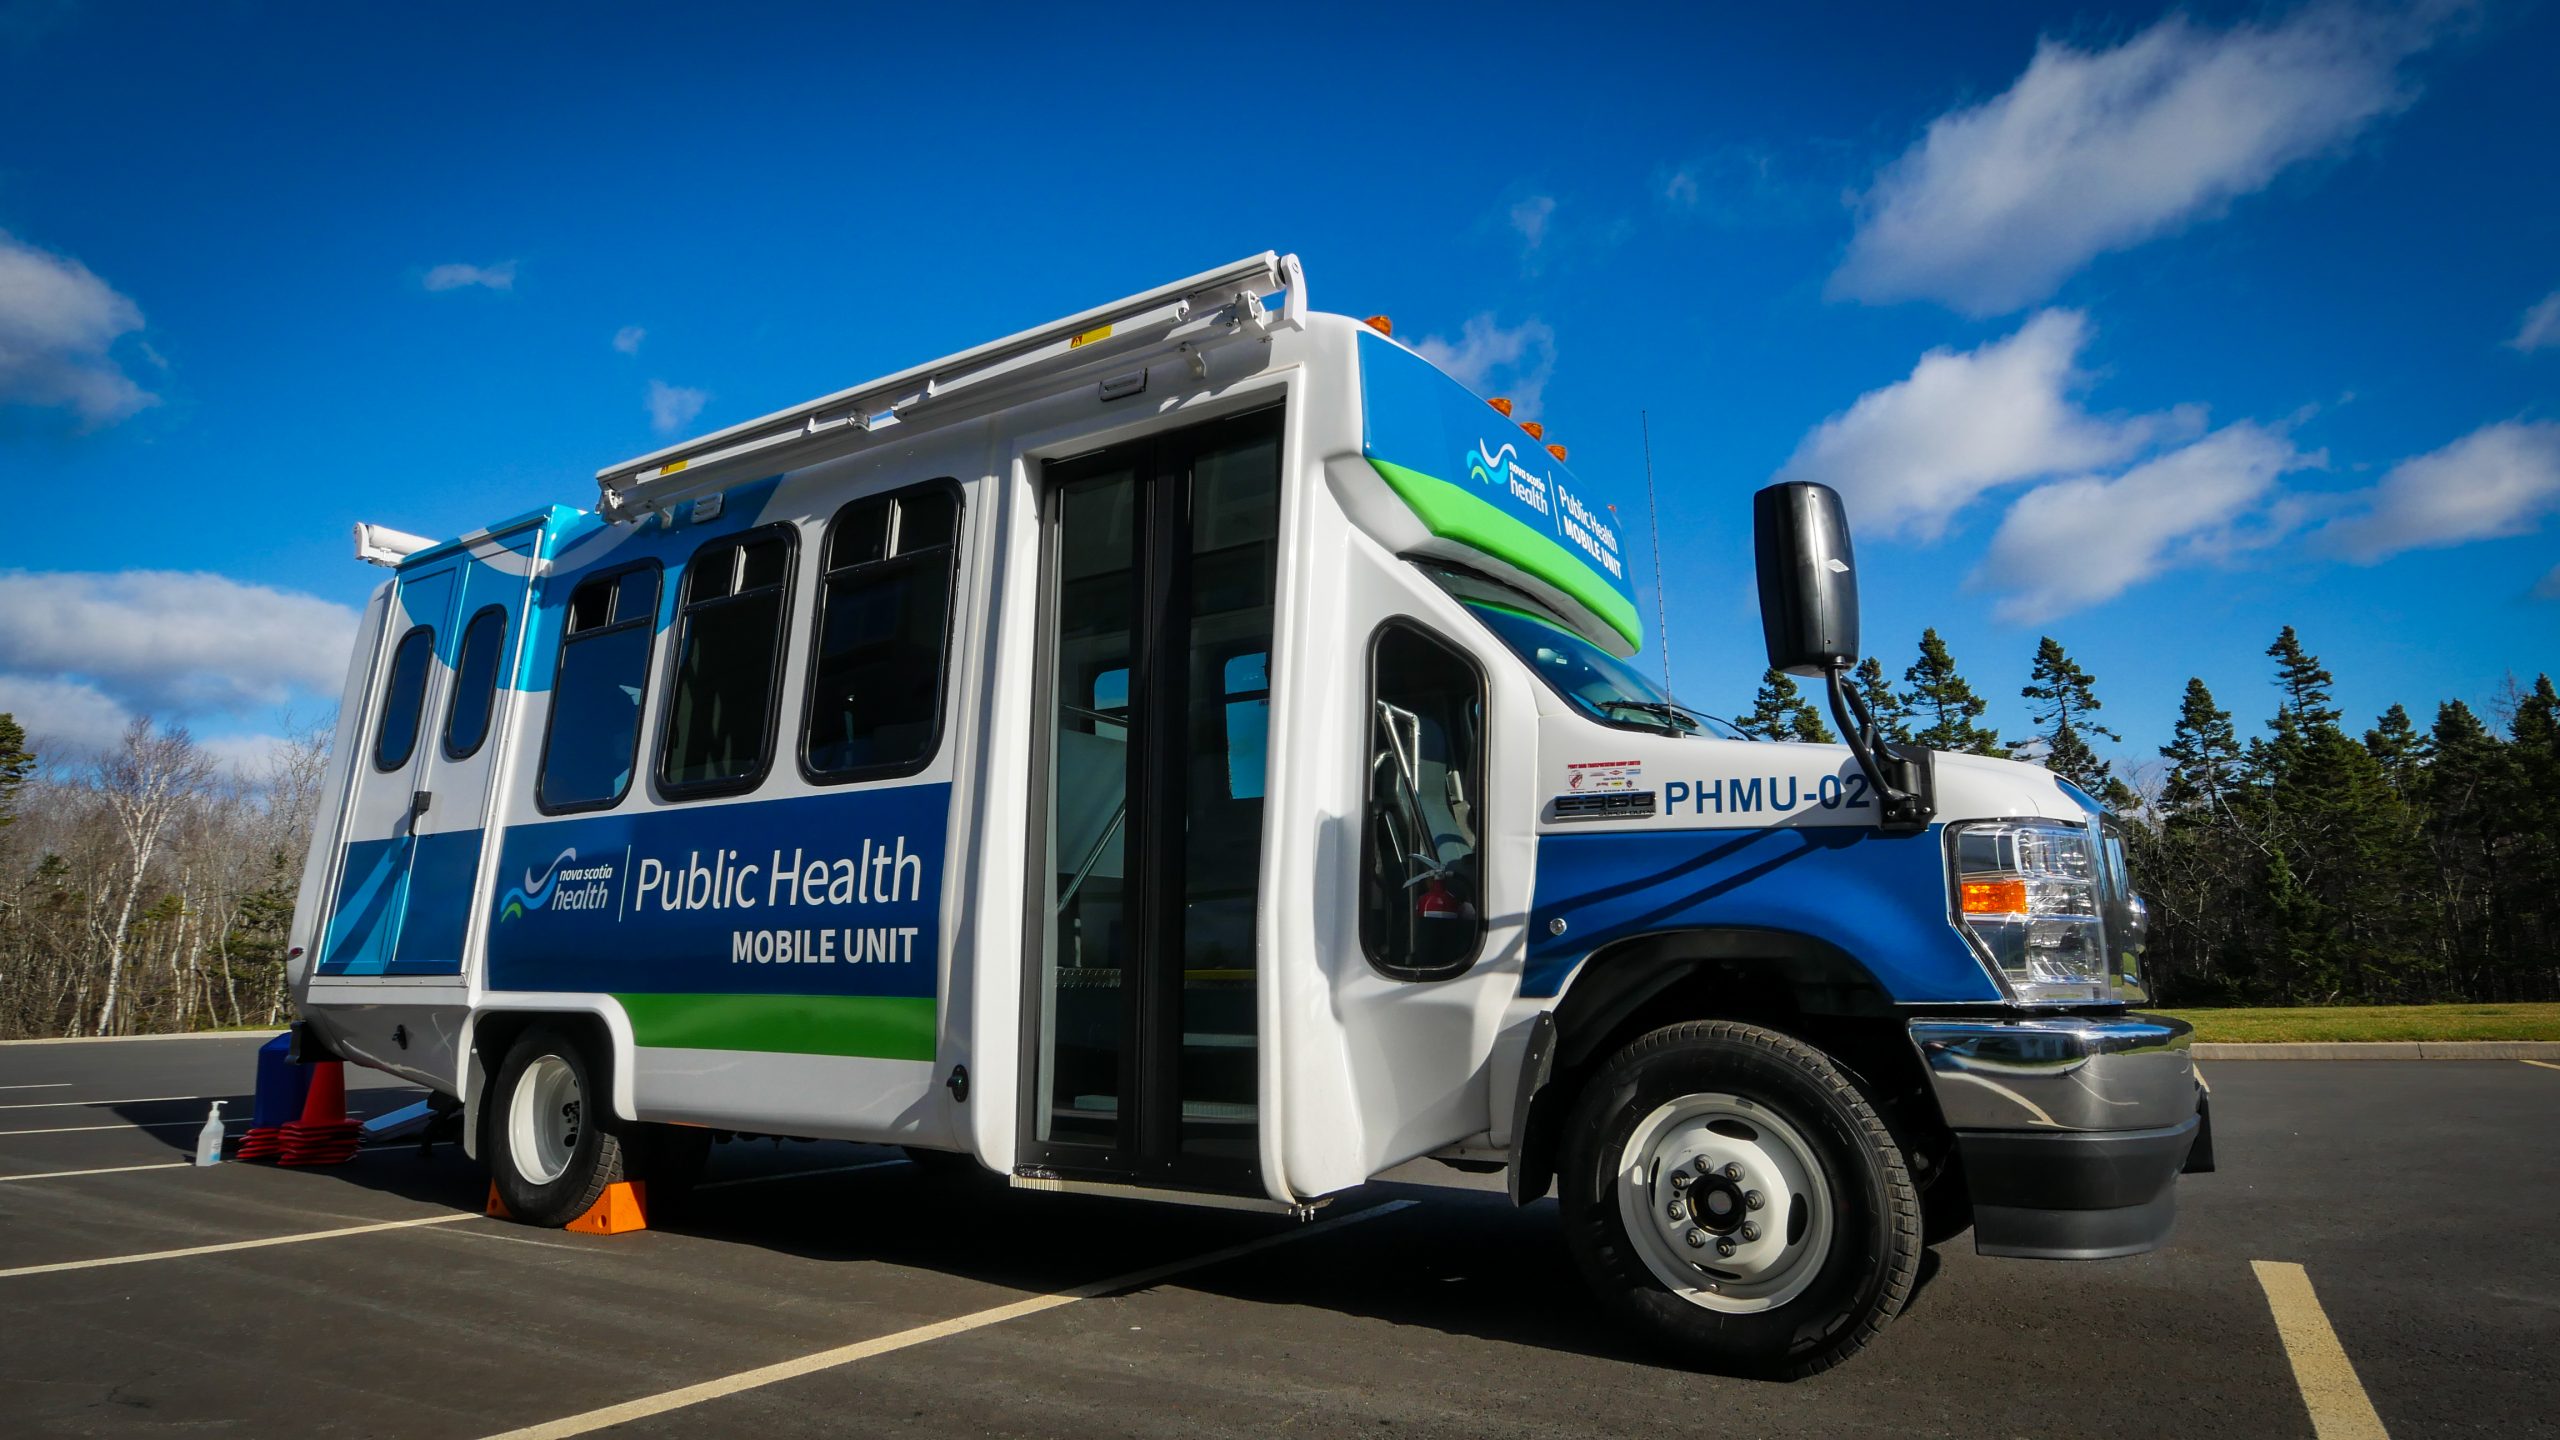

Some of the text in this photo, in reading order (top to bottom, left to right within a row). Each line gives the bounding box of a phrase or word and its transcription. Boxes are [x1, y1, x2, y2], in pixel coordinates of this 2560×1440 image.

[1508, 461, 1546, 493] nova scotia
[1510, 471, 1549, 516] health
[1558, 484, 1619, 555] Public Health
[1563, 515, 1622, 580] MOBILE UNIT
[1665, 774, 1870, 816] PHMU-02
[559, 863, 614, 881] nova scotia
[635, 836, 922, 912] Public Health
[551, 881, 609, 911] health
[732, 927, 919, 964] MOBILE UNIT
